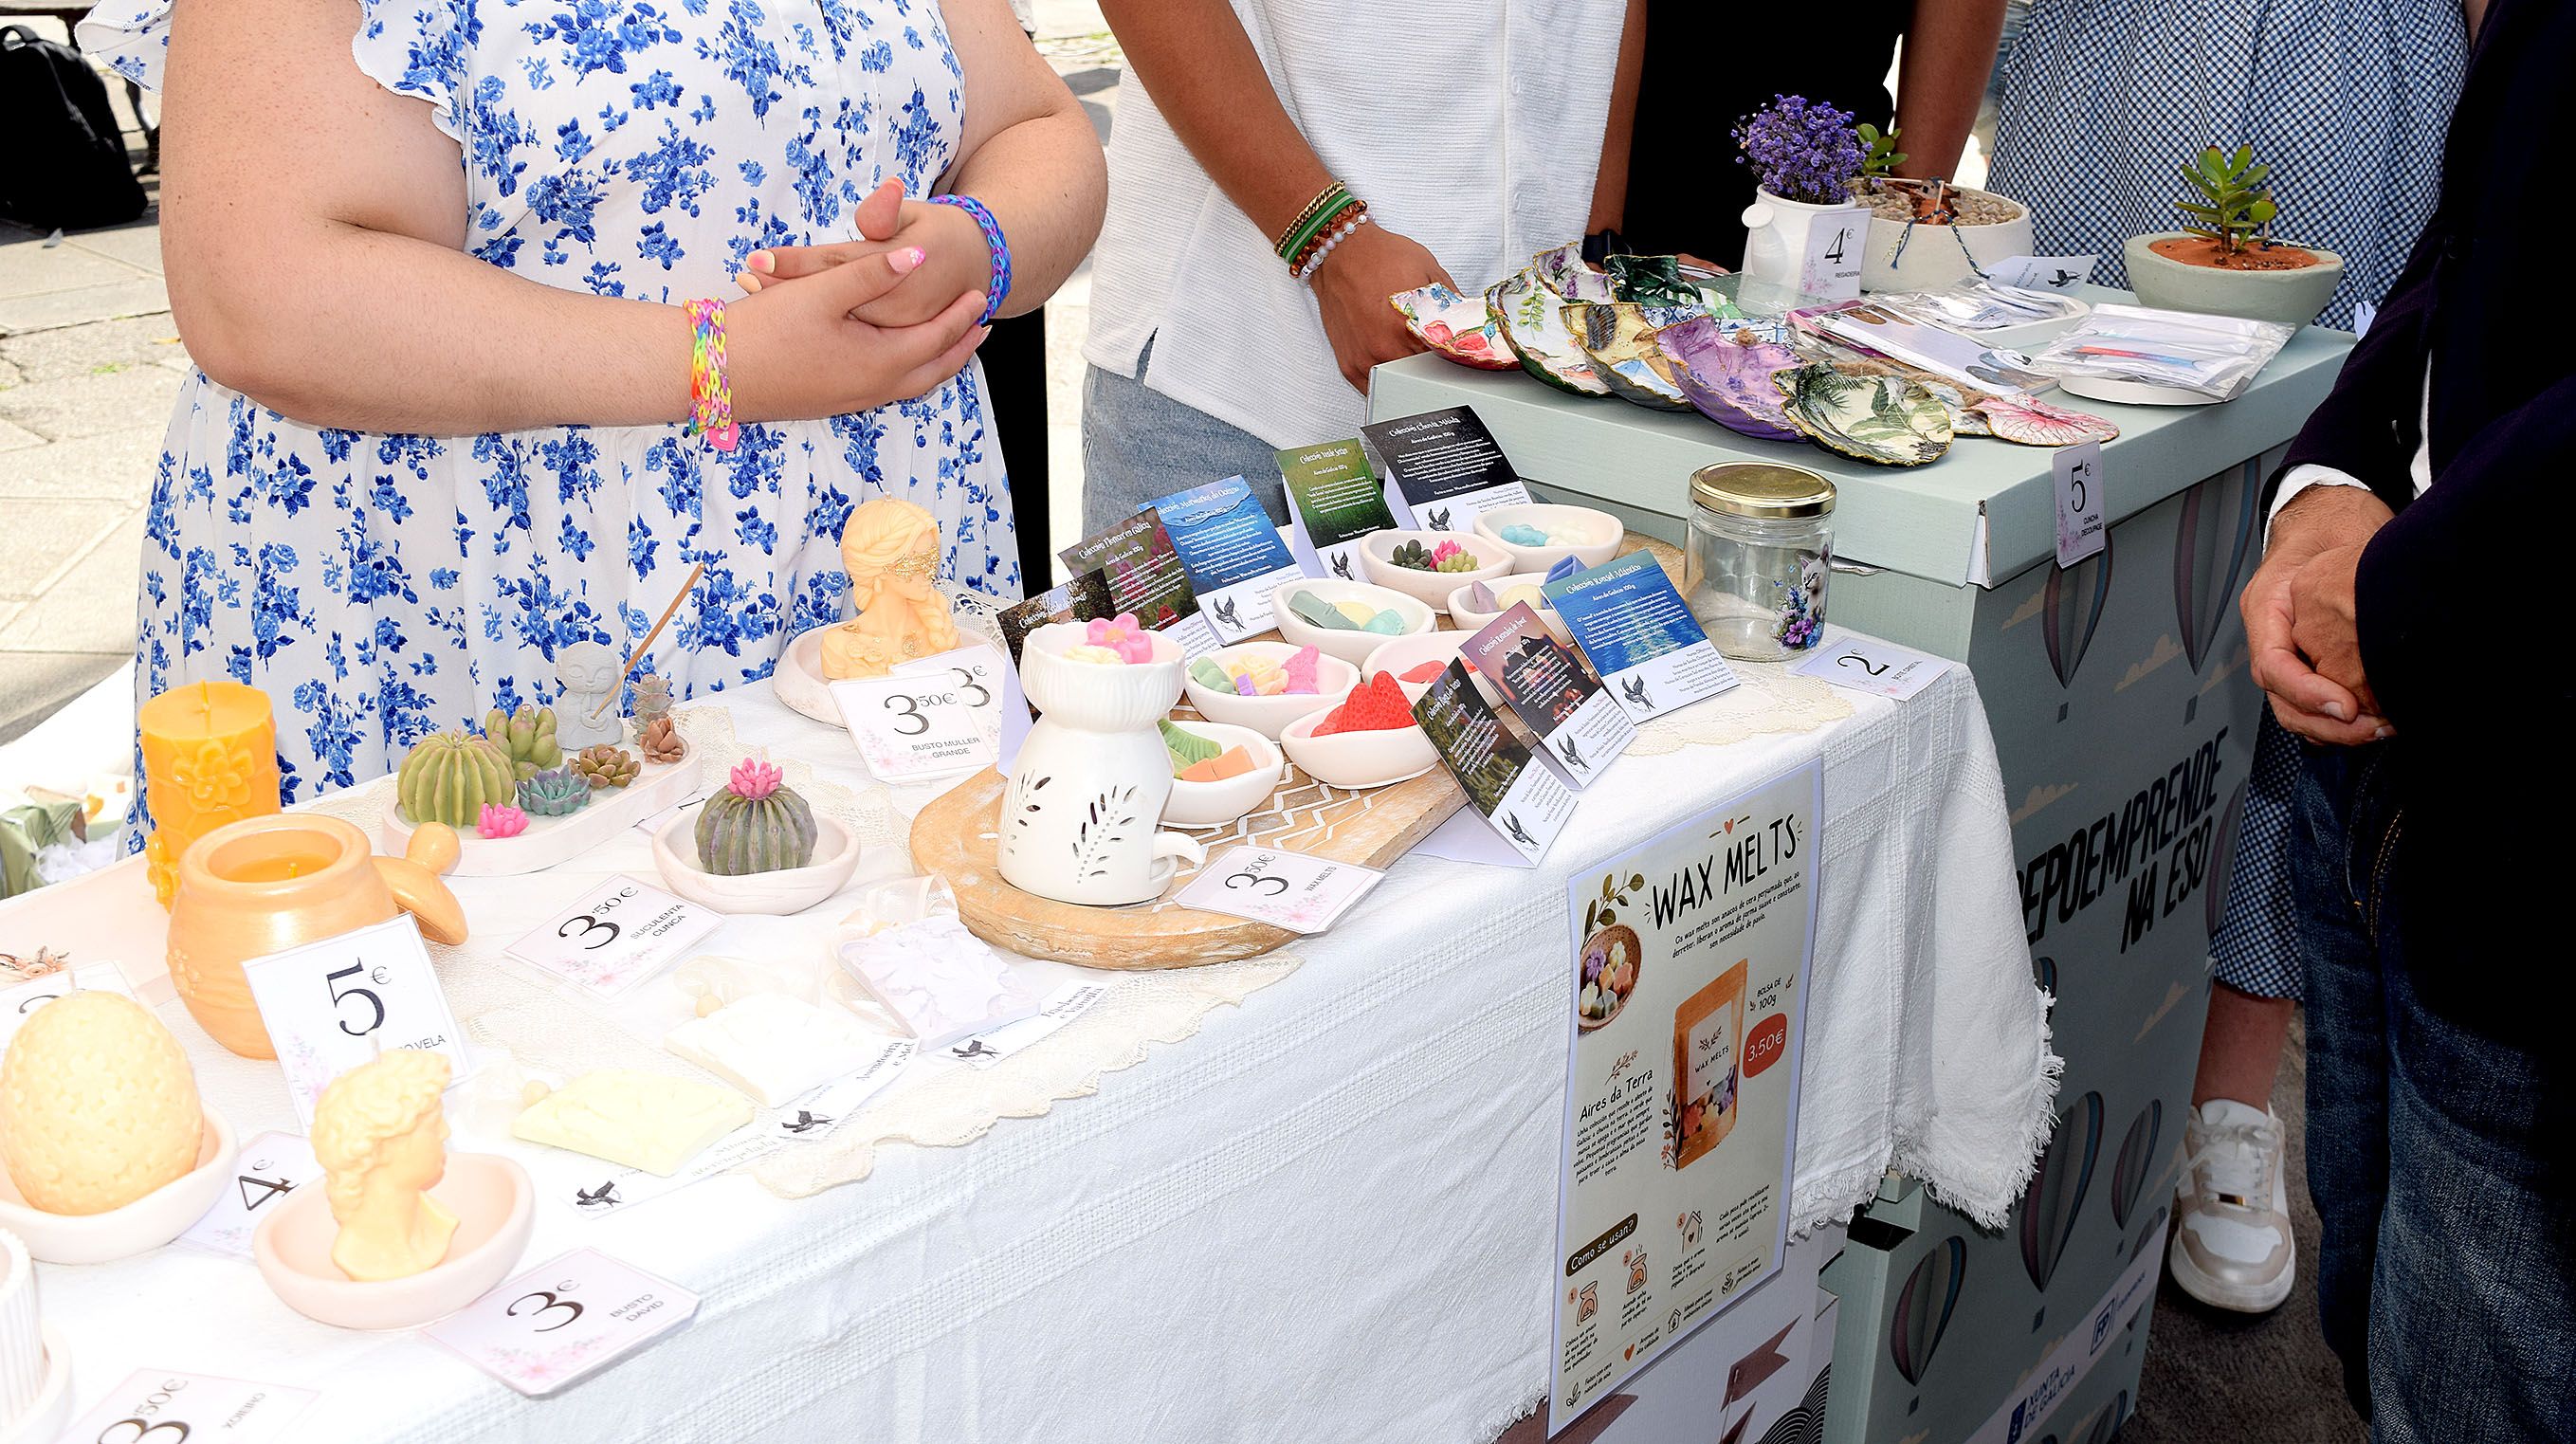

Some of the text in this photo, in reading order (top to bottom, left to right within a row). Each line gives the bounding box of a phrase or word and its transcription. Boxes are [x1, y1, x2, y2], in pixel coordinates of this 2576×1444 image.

[1079, 539, 1105, 558] Colección
[1131, 521, 1151, 534] Galicia
[1566, 577, 1594, 594] Colección
[912, 737, 980, 751] BUSTO MULLER
[932, 747, 971, 759] GRANDE
[1305, 866, 1337, 891] WAX MELTS
[1653, 813, 1797, 930] WAX MELTS
[2120, 815, 2213, 954] NA ESO
[630, 904, 684, 939] SUCULENTA
[652, 914, 686, 937] CUNCA
[1684, 929, 1694, 939] wax
[1695, 921, 1709, 933] melts
[1711, 915, 1720, 924] son
[1721, 905, 1737, 919] anacos
[1739, 900, 1745, 909] de
[1745, 895, 1756, 905] cera
[1696, 931, 1713, 944] liberan
[1719, 920, 1734, 932] aroma
[1735, 913, 1741, 923] de
[1758, 898, 1771, 910] suave
[1709, 940, 1718, 948] sen
[1719, 923, 1745, 942] necesidade
[1745, 920, 1751, 928] de
[1758, 978, 1781, 996] BOLSA DE
[414, 1034, 446, 1050] VELA
[1695, 1045, 1729, 1073] WAX MELTS
[1580, 1069, 1653, 1123] Aires da Terra
[1571, 1219, 1634, 1270] Como se usan?
[610, 1293, 653, 1318] BUSTO
[626, 1301, 664, 1322] DAVID
[2024, 1364, 2075, 1429] DE GALICIA
[2027, 1366, 2059, 1409] XUNTA
